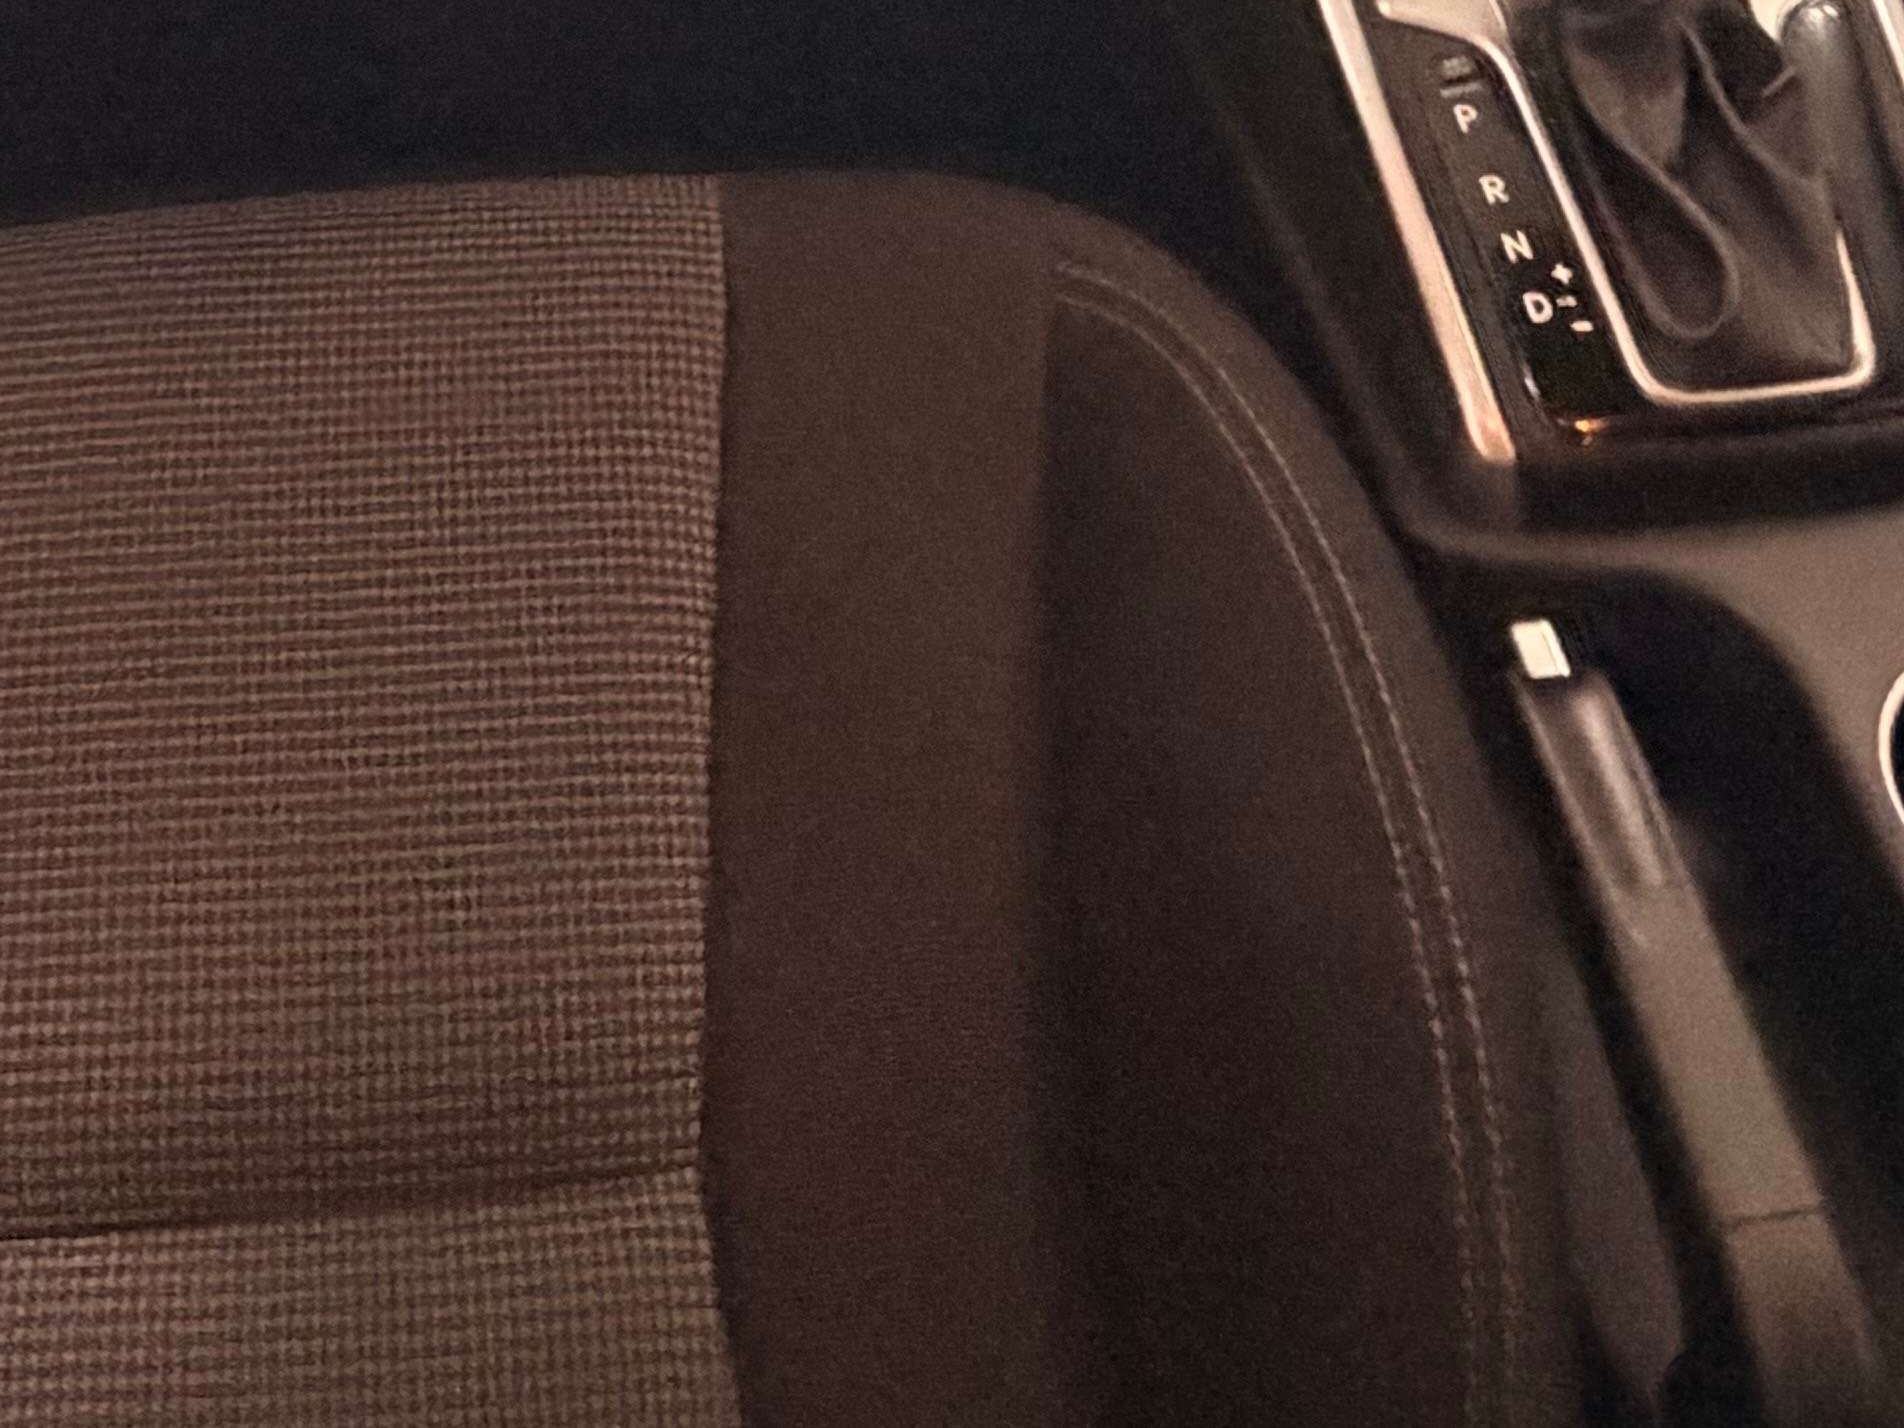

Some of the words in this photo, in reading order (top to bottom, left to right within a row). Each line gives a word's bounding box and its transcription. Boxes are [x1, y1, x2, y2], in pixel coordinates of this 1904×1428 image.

[1453, 104, 1478, 134] P
[1478, 174, 1509, 205] R
[1500, 230, 1534, 264] N
[1522, 291, 1553, 324] D
